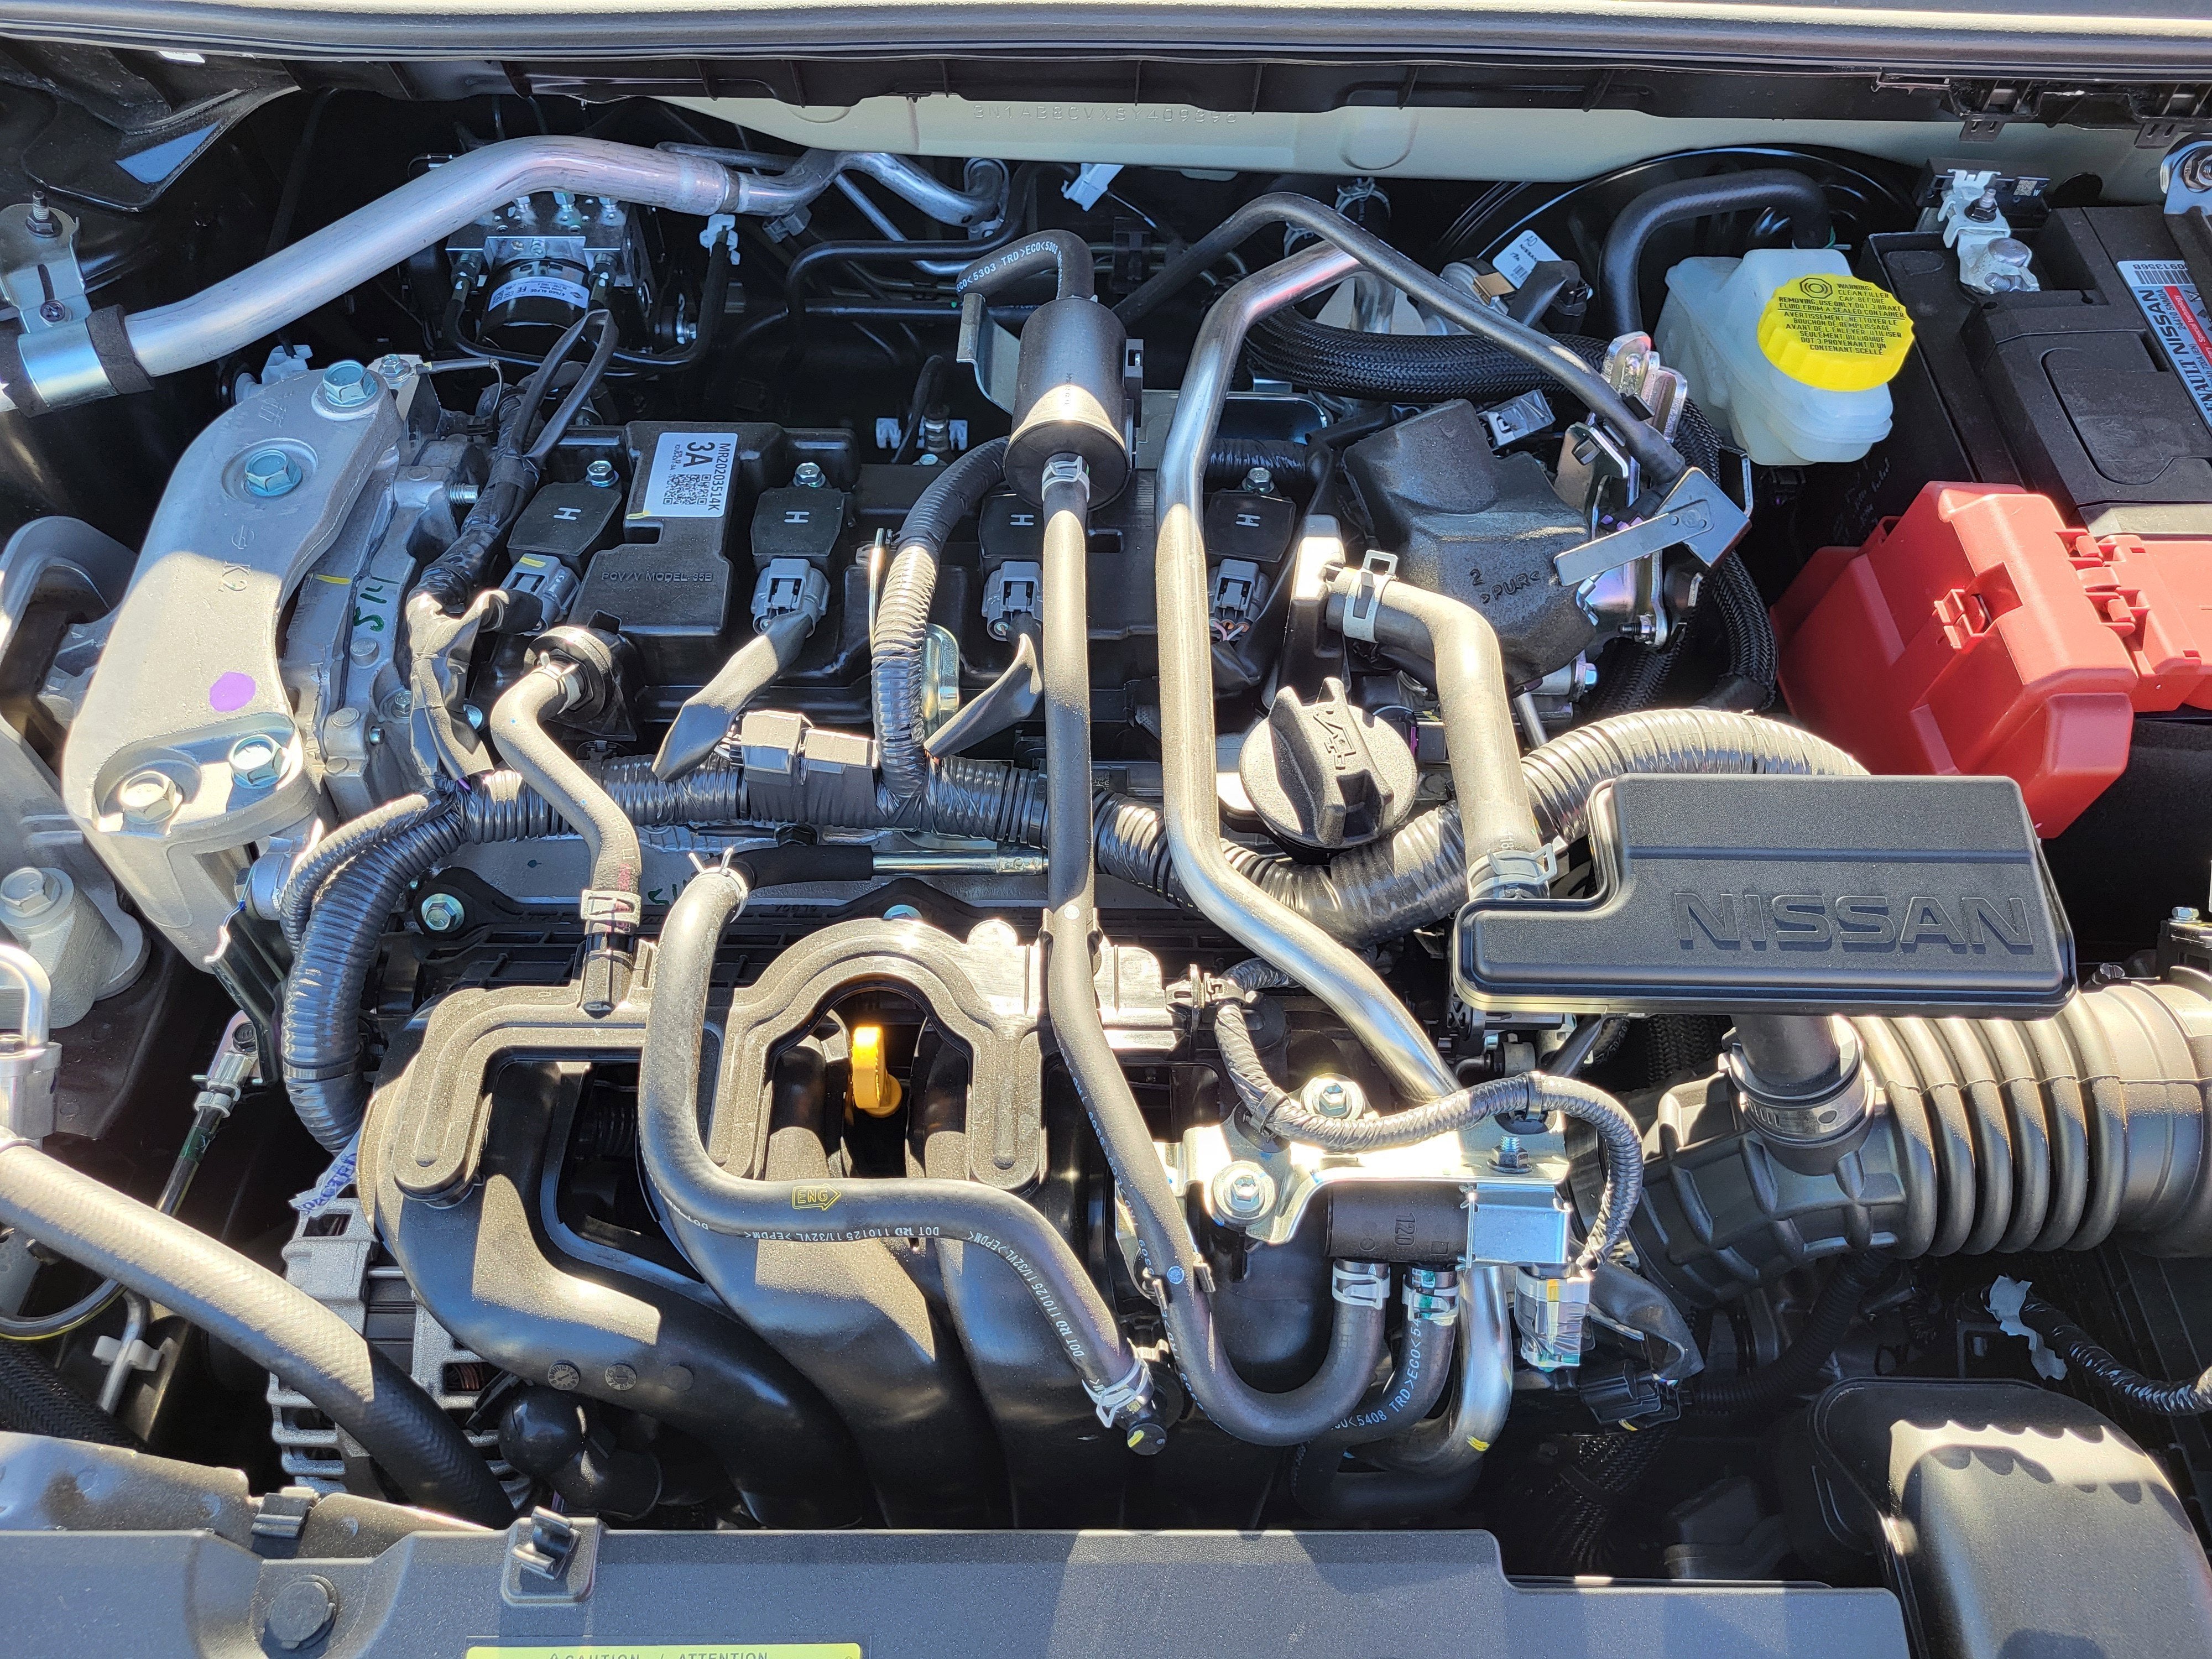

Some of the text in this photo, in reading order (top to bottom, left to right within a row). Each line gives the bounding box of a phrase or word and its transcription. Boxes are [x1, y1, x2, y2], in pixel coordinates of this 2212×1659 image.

[1837, 283, 1872, 291] WARNING:
[1839, 321, 1891, 331] REMPLISSAGE
[1849, 316, 1887, 325] NETTOYER
[2169, 312, 2187, 330] 24410
[1799, 331, 1843, 340] SEULEMENT
[1857, 335, 1885, 343] LIQUIDE
[1824, 339, 1868, 348] PROVENANT
[1809, 344, 1853, 353] CONTENANT
[2143, 289, 2212, 414] ENAULT NISSAN
[683, 442, 716, 468] 3A
[708, 443, 732, 511] MR20203514K
[1469, 568, 1485, 586] 2
[1673, 892, 2034, 953] NISSAN
[797, 1192, 829, 1204] ENG
[918, 1226, 940, 1237] DOT
[1394, 1212, 1416, 1246] 120
[1065, 1339, 1085, 1357] DOT
